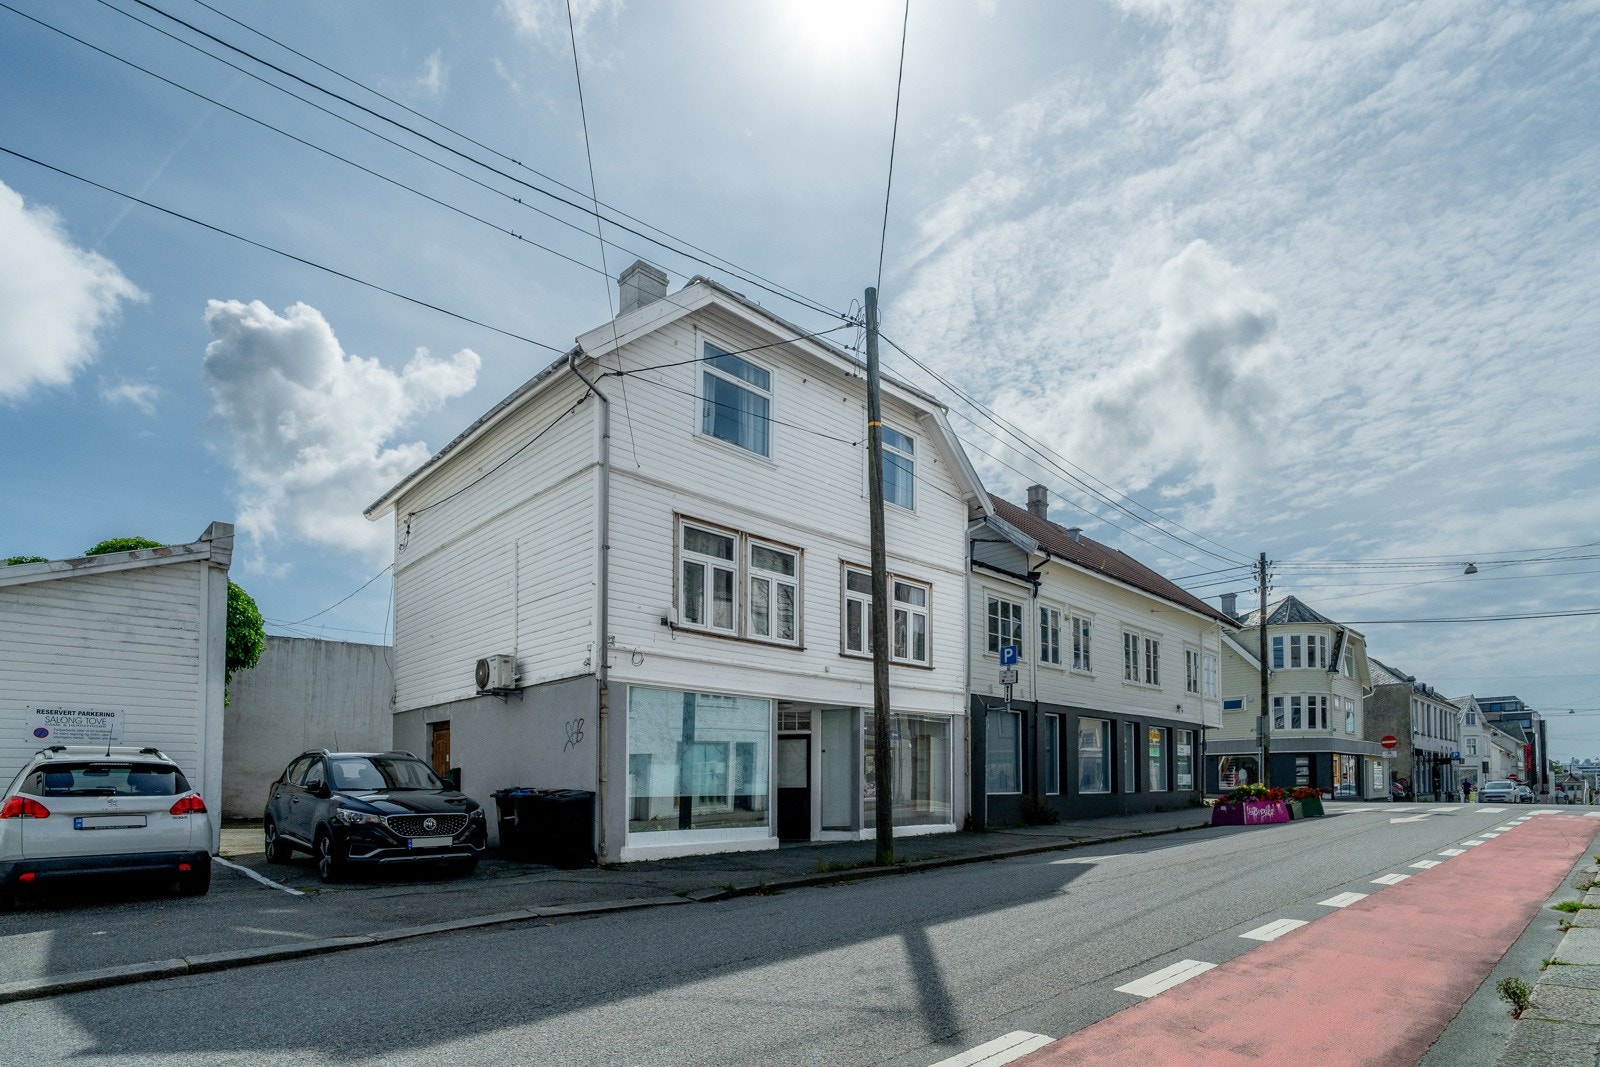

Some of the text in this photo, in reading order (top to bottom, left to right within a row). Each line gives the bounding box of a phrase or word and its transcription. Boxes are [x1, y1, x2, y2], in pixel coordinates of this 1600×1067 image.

[1004, 648, 1013, 663] P
[36, 708, 115, 718] RESERVERT PARKERING
[44, 715, 107, 726] SALONG TOVE
